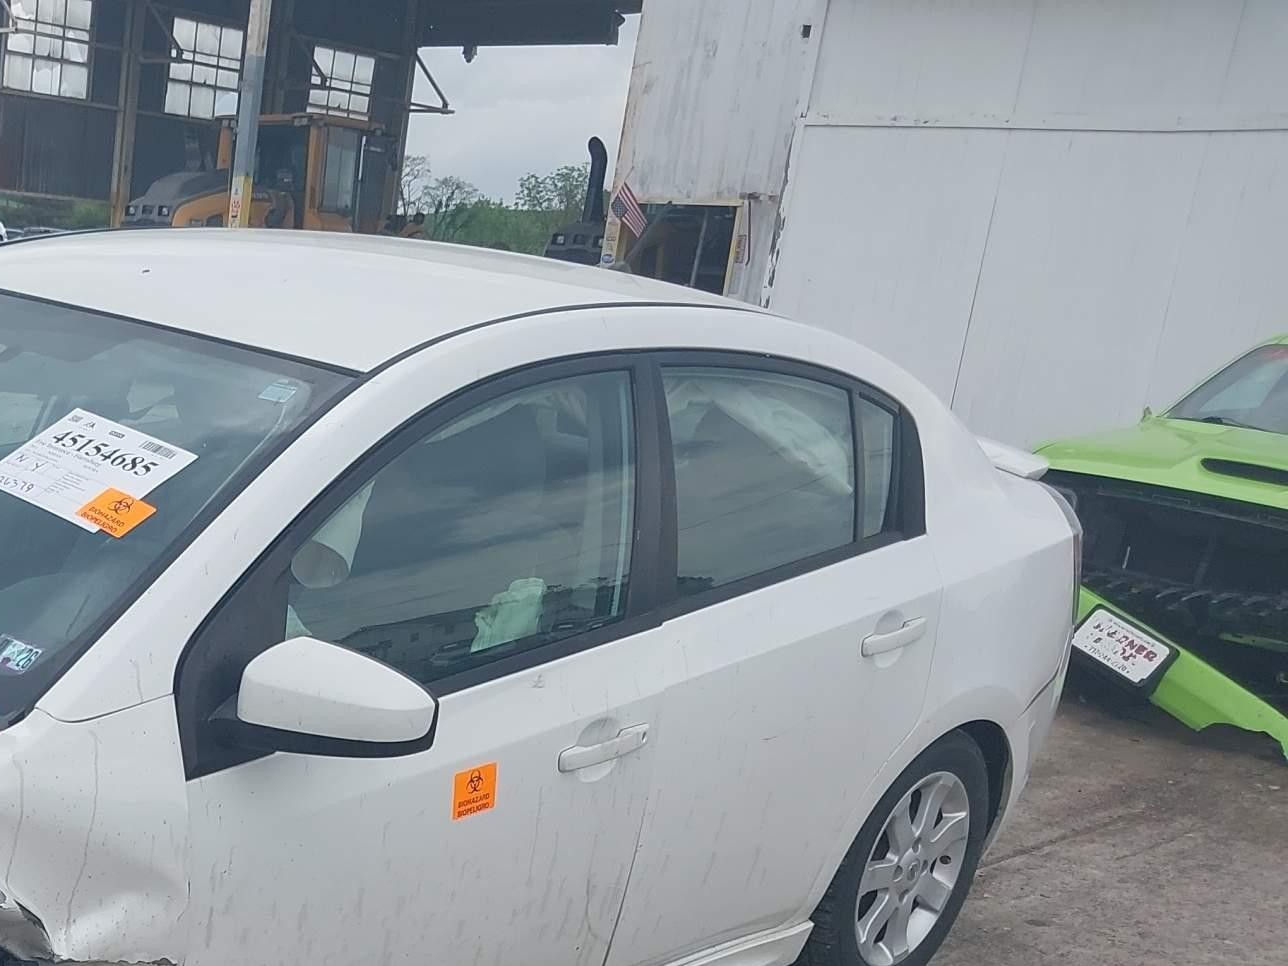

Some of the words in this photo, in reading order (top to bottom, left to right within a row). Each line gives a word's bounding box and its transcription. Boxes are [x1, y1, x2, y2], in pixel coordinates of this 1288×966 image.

[53, 429, 161, 477] 45154685
[81, 512, 119, 533] BIOPELIGRO
[88, 505, 125, 527] BIOHAZARD
[15, 648, 39, 669] 26
[457, 792, 490, 809] BIOHAZARD
[457, 801, 490, 818] BIOPELIGRO
